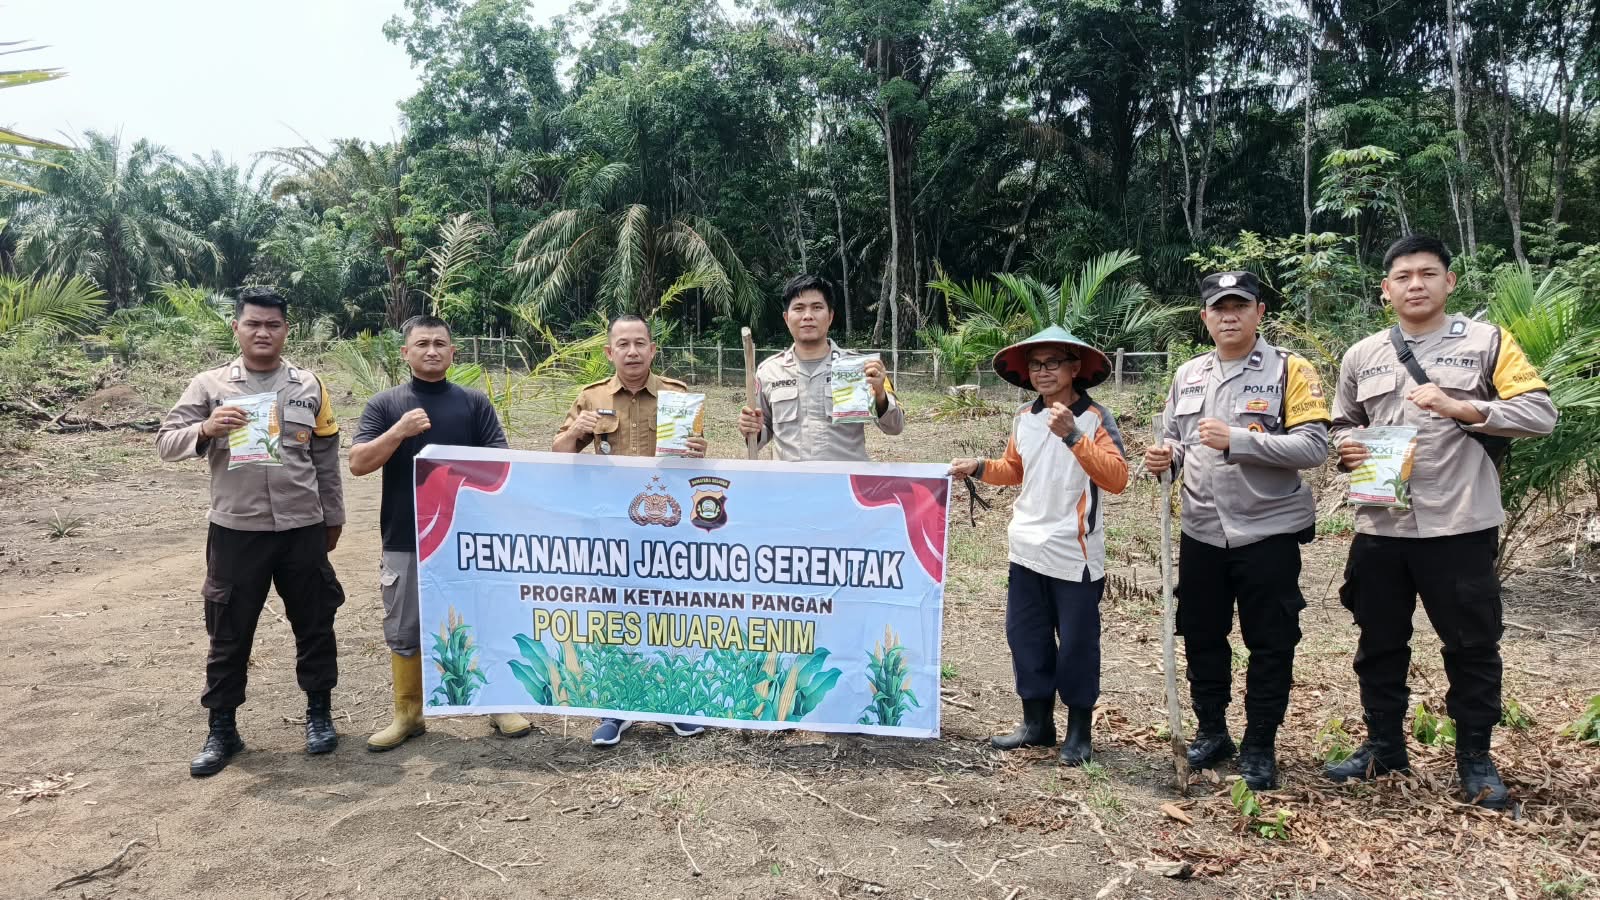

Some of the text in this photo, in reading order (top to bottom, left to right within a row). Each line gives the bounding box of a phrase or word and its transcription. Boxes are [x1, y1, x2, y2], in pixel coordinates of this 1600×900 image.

[1435, 357, 1474, 367] POLRI
[1243, 385, 1280, 394] POLRI
[458, 532, 904, 589] PENANAMAN JAGUNG SERENTAK
[520, 585, 833, 614] PROGRAM KETAHANAN PANGAN
[533, 608, 815, 654] POLRES MUARA ENIM
